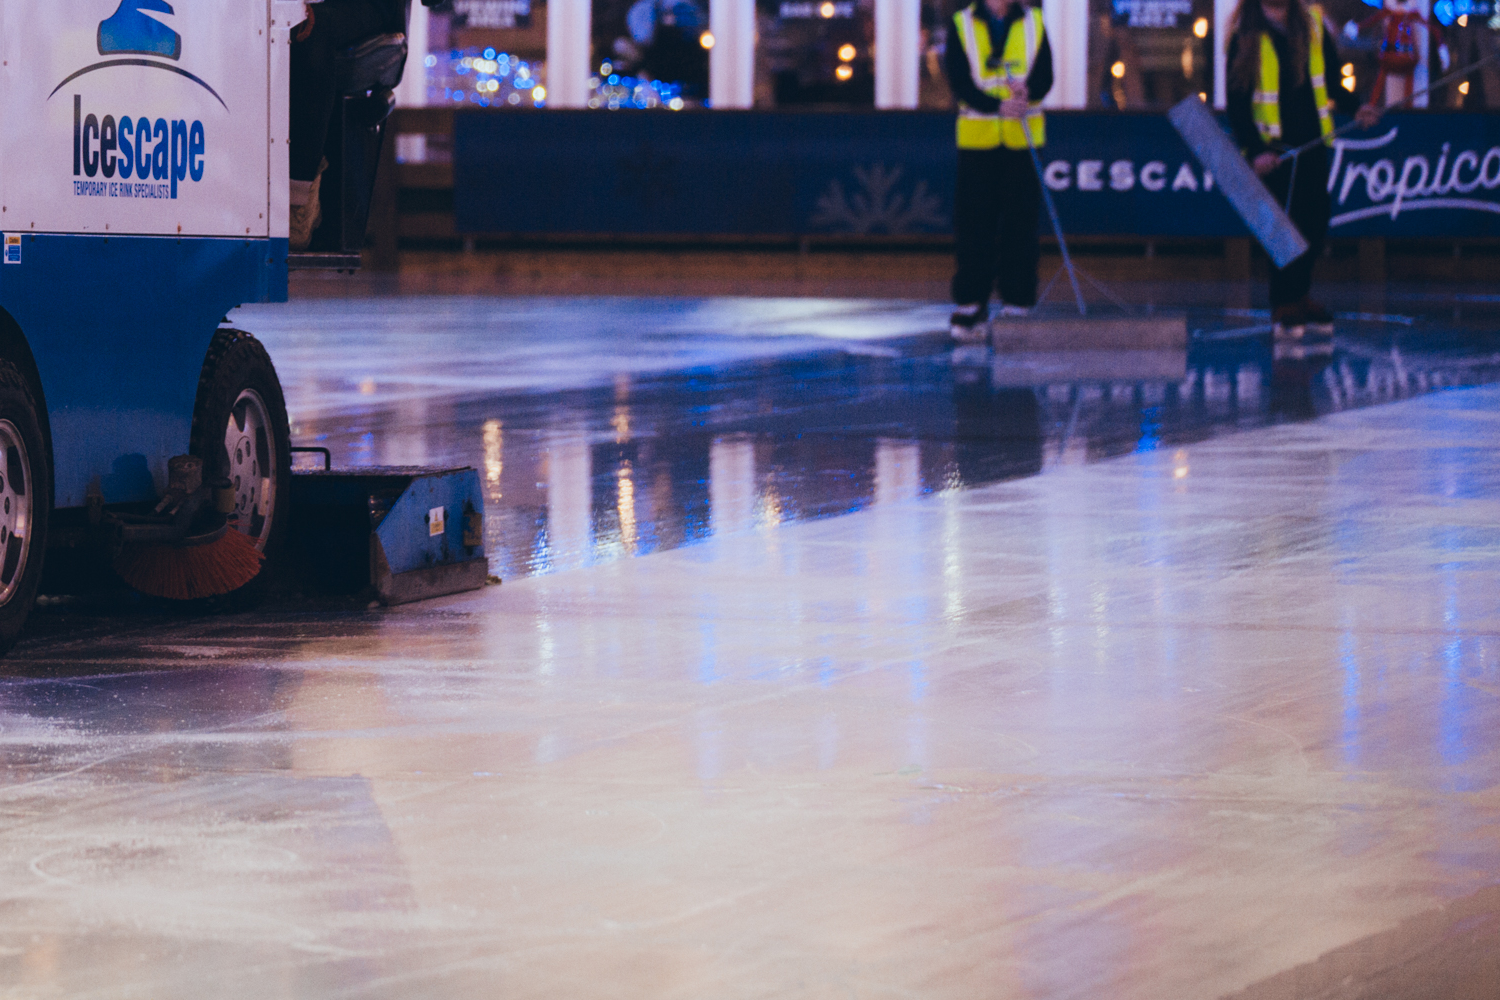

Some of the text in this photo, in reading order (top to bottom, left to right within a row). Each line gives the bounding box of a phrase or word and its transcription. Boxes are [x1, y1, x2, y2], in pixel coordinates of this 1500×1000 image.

[73, 94, 205, 199] Icescape
[73, 181, 169, 199] TEMPORARY ICE RINK SPECIALISTS
[1043, 159, 1214, 192] CESCA
